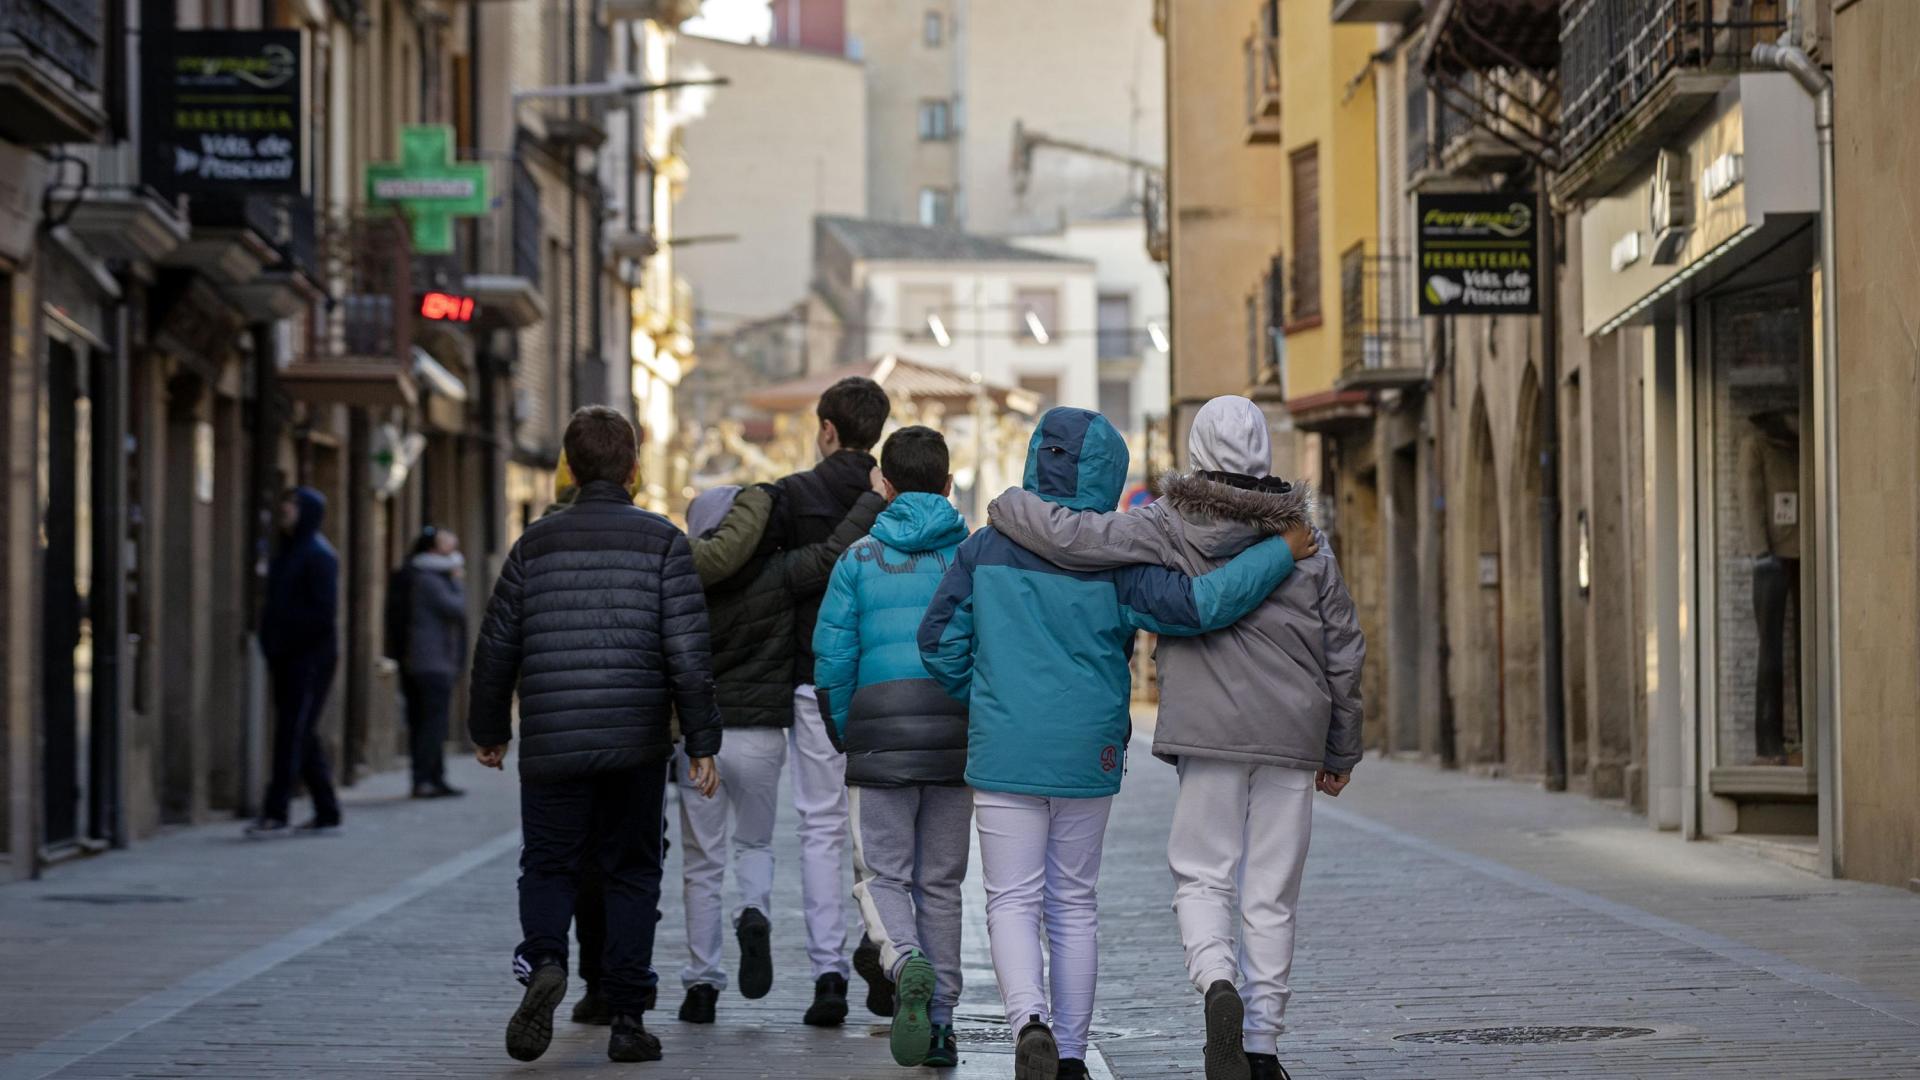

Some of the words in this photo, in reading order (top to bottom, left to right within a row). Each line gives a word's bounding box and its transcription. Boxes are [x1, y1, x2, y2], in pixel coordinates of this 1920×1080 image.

[177, 110, 292, 130] RRETERÍA
[1424, 250, 1530, 268] FERRETERÍA
[1504, 270, 1530, 289] de
